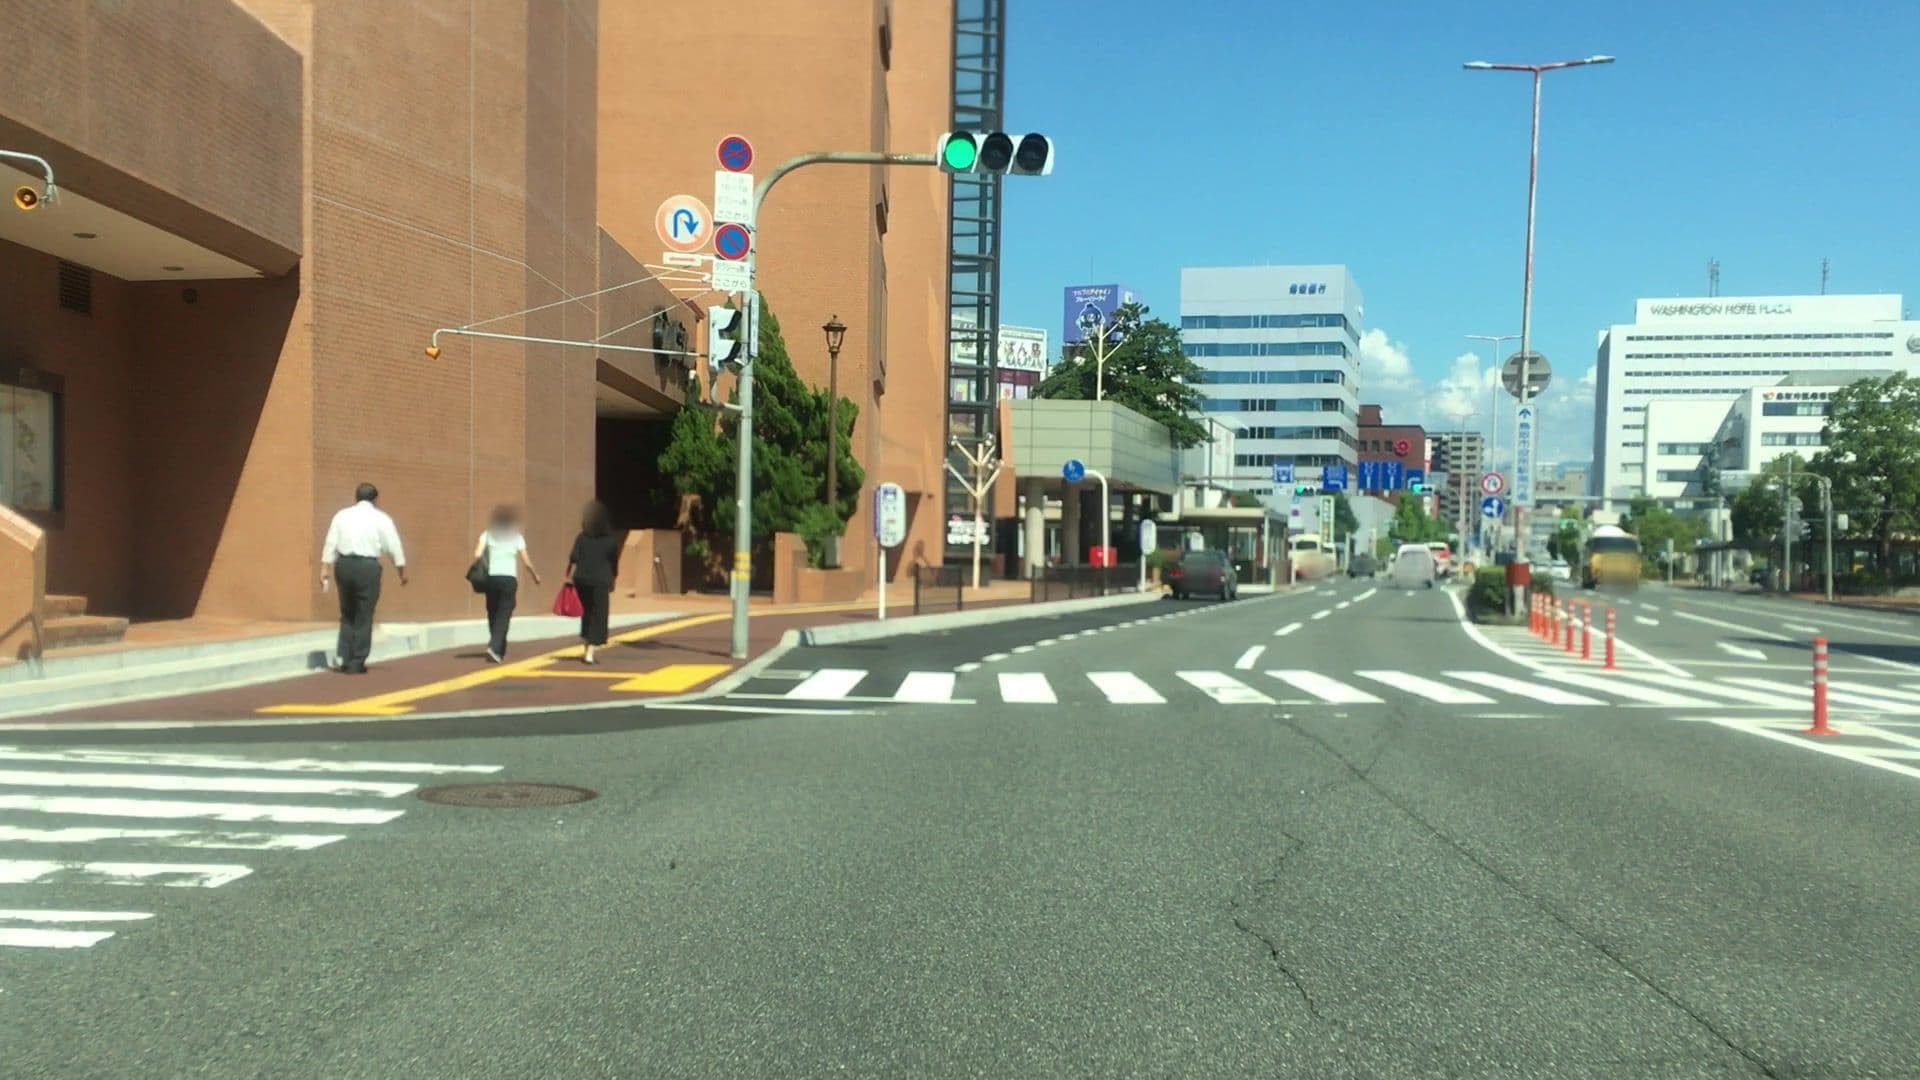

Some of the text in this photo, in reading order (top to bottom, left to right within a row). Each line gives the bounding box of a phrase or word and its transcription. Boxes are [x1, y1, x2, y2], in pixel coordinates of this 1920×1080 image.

[1650, 302, 1792, 316] WASHINGTON HOTEL PLAZA
